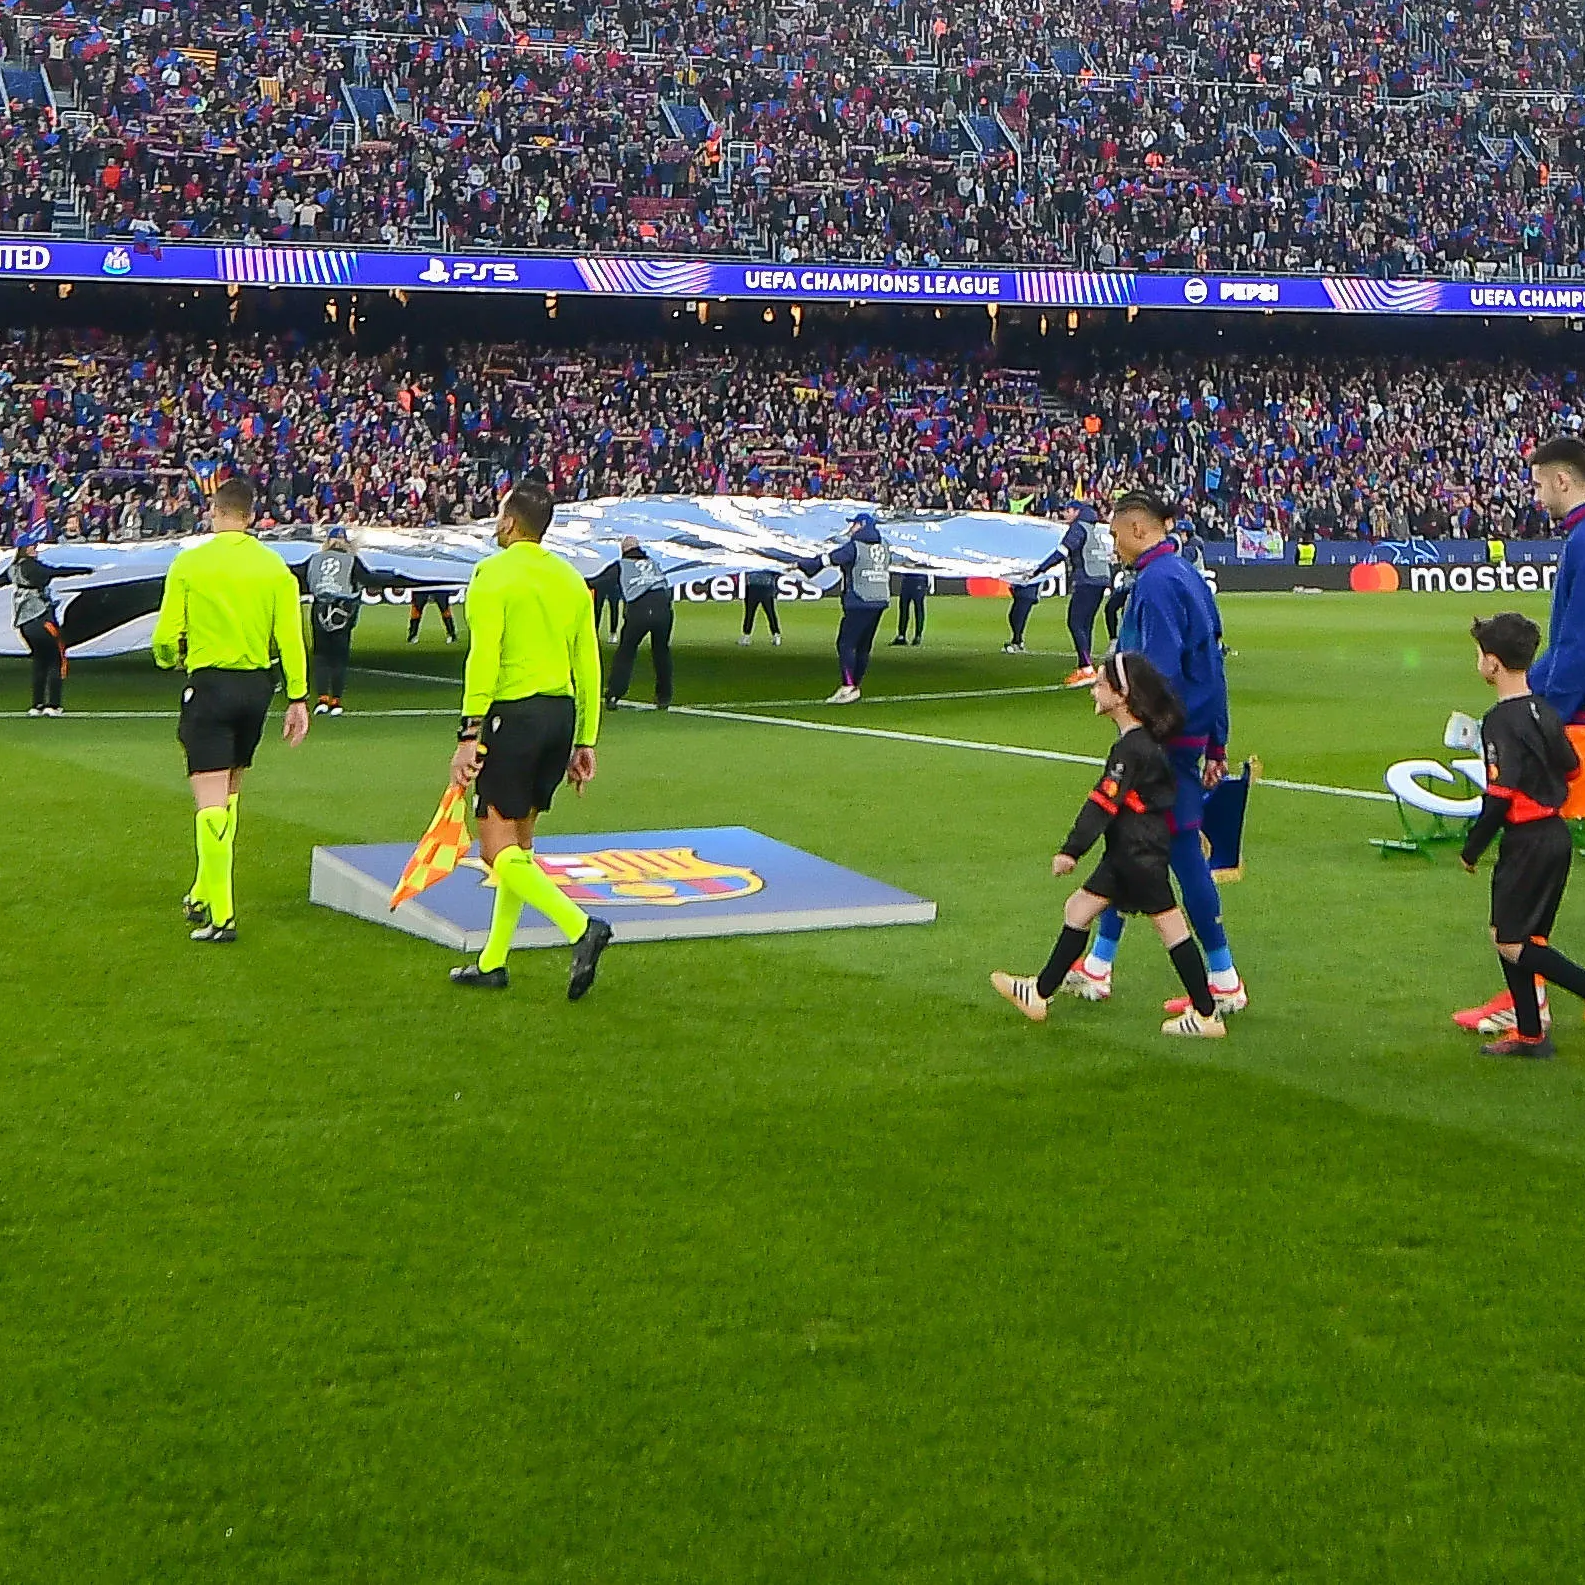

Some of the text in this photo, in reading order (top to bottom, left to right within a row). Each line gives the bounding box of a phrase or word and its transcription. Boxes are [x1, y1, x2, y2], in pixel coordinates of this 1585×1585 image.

[453, 262, 517, 282] PS5
[745, 270, 1000, 295] UEFA CHAMPIONS LEAGUE
[1470, 288, 1517, 307] UEFA
[1410, 560, 1558, 592] master
